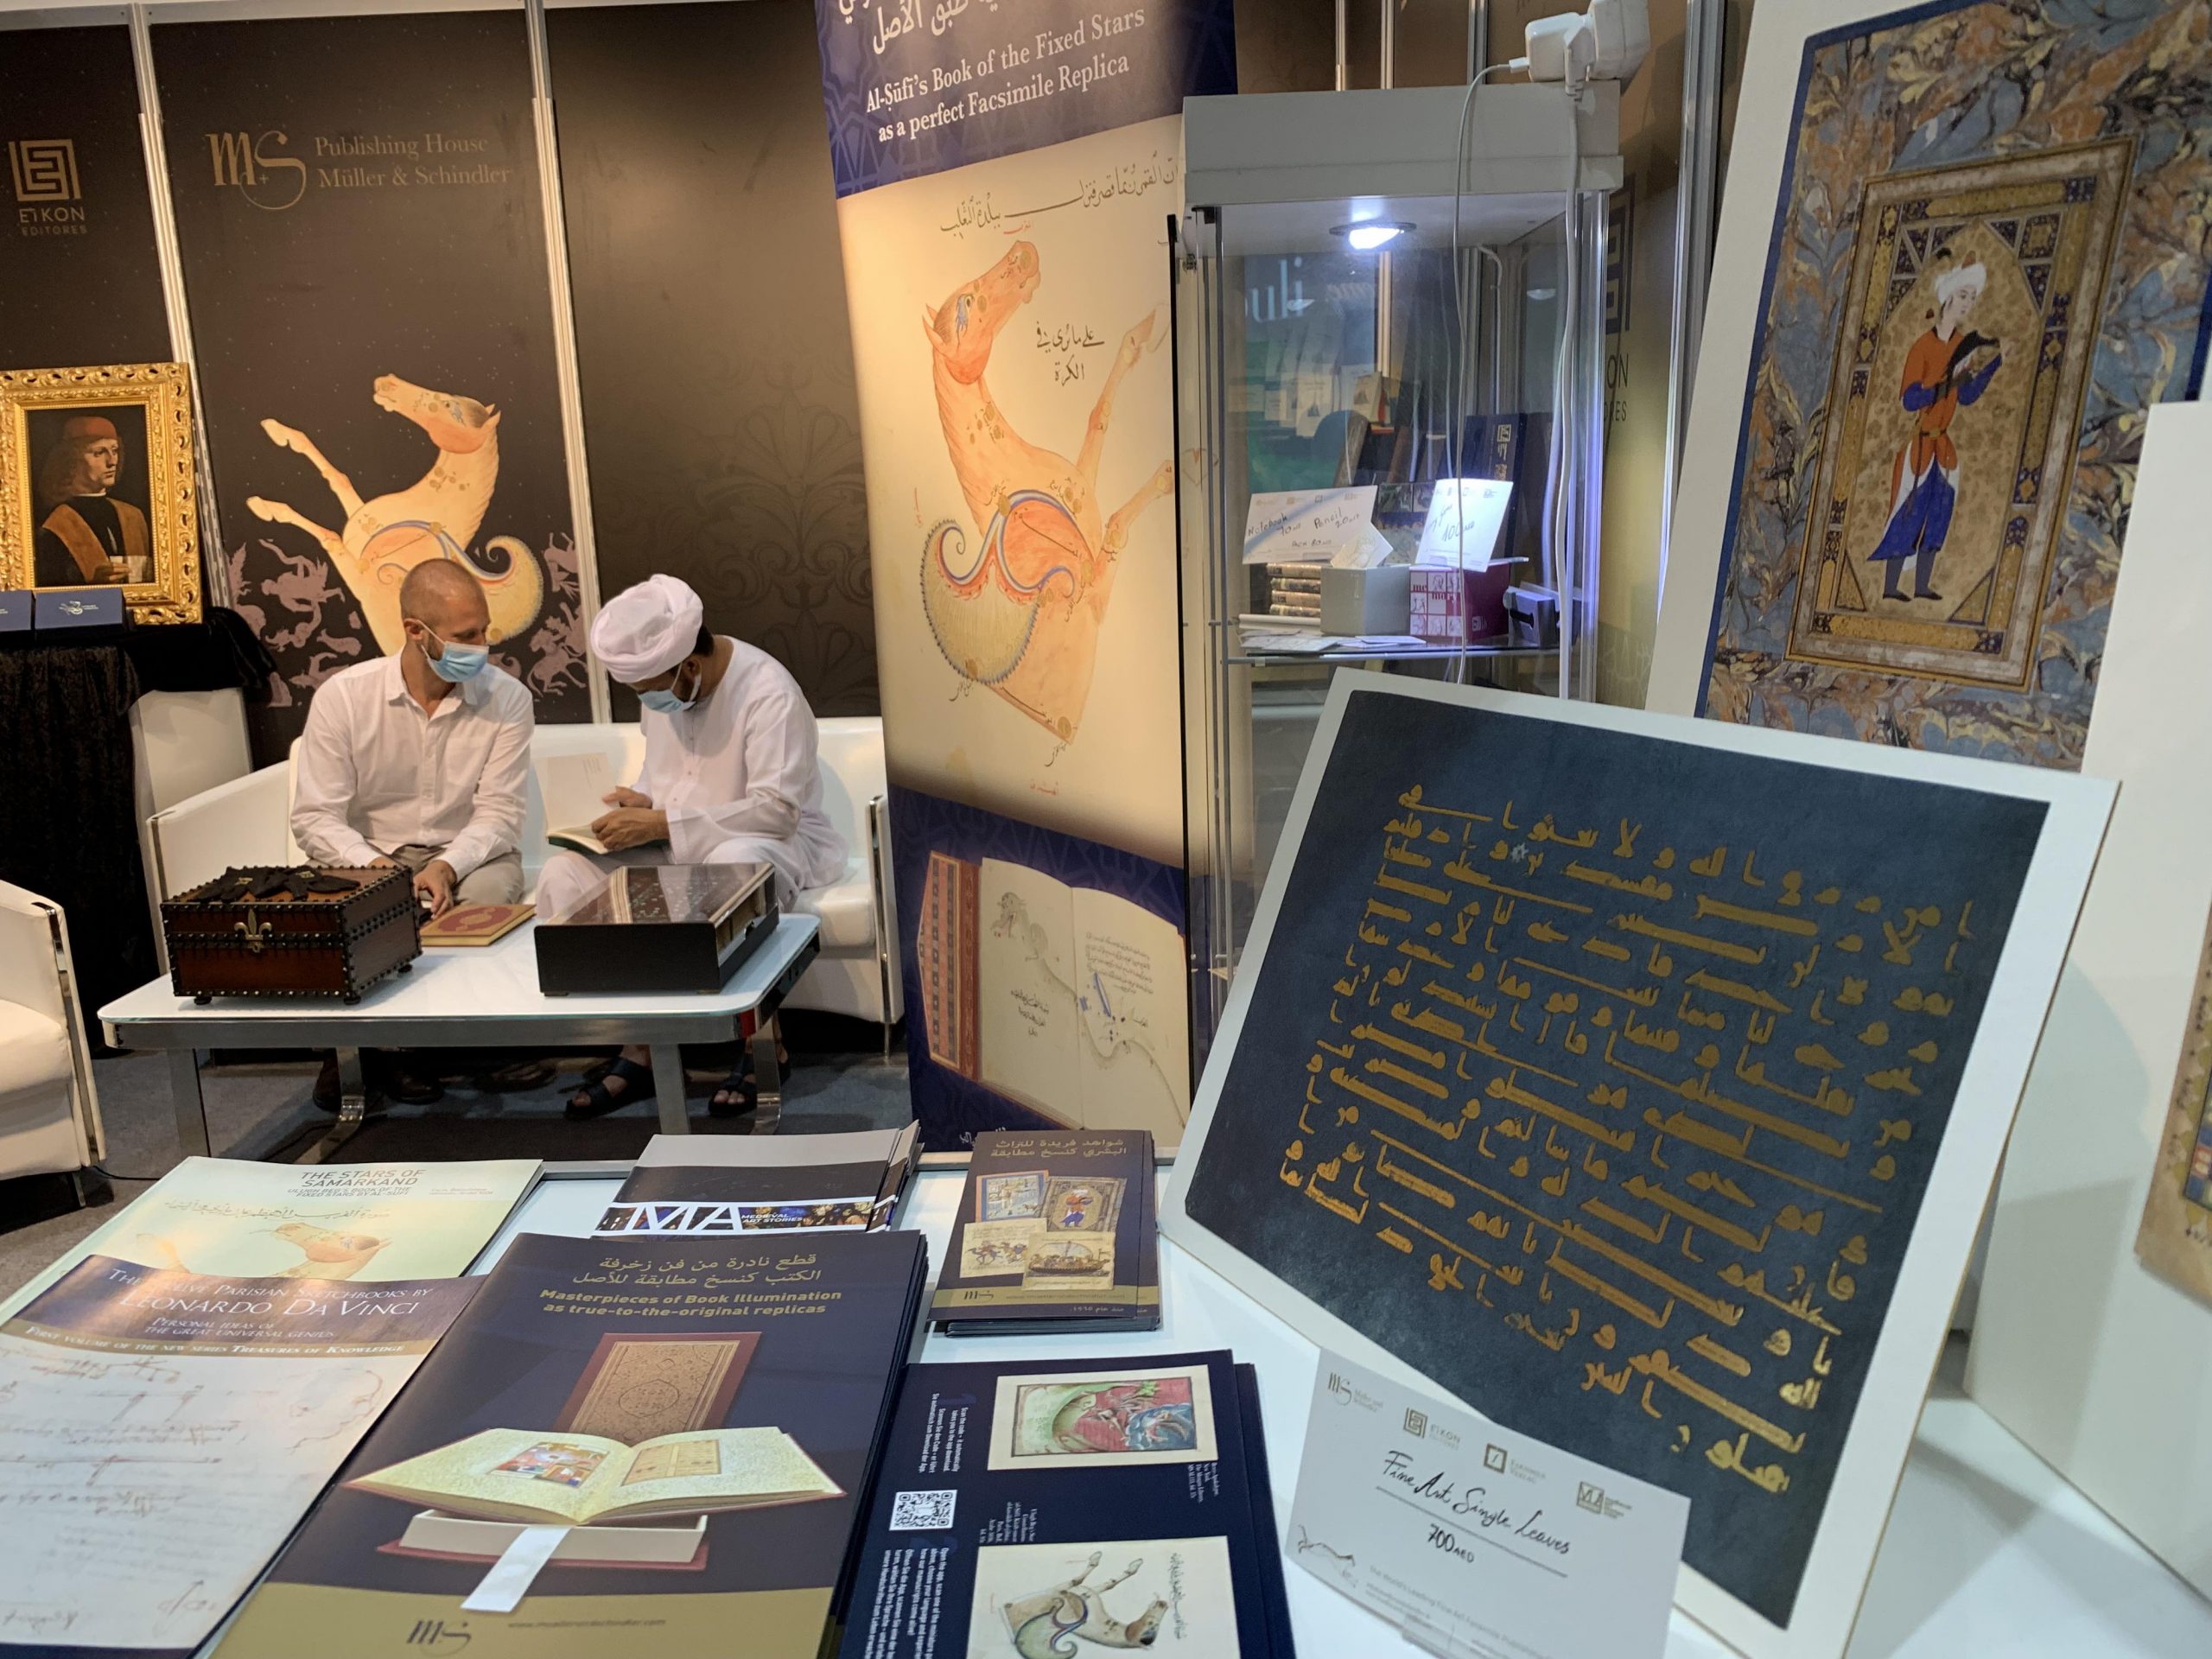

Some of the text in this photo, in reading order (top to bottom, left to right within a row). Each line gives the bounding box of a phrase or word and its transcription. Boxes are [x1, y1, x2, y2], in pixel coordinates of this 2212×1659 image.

[932, 58, 972, 92] Book
[977, 50, 995, 77] of
[1001, 44, 1031, 71] the
[1036, 20, 1086, 60] Fixed
[1091, 9, 1146, 41] Stars
[879, 54, 1129, 143] as a perfect Facsimile Replica
[315, 133, 489, 158] Publishing House
[320, 165, 512, 188] Müller & Schindler
[22, 226, 87, 236] EDITORES
[301, 1171, 338, 1179] THE
[339, 1170, 397, 1179] STARS
[302, 1178, 419, 1187] SAMARKAND
[599, 1254, 817, 1272] قطع نادرة من فن زخرفة
[572, 1269, 821, 1288] الكتب كنسخ مطابقة للأصل
[213, 1285, 288, 1296] PARISIAN
[294, 1287, 408, 1299] SKETCHBOOKS
[412, 1288, 434, 1297] BY
[539, 1289, 842, 1304] Masterpieces of Book Illumination
[119, 1289, 273, 1314] LEONARDO
[341, 1300, 421, 1316] VINCI
[569, 1305, 749, 1318] true-to-the-original
[753, 1305, 826, 1316] replicas
[151, 1317, 215, 1327] PERSONAL
[26, 1326, 60, 1339] FIRST
[64, 1336, 111, 1347] VOLUME
[1383, 1450, 1570, 1555] Fine Art Single Leaves
